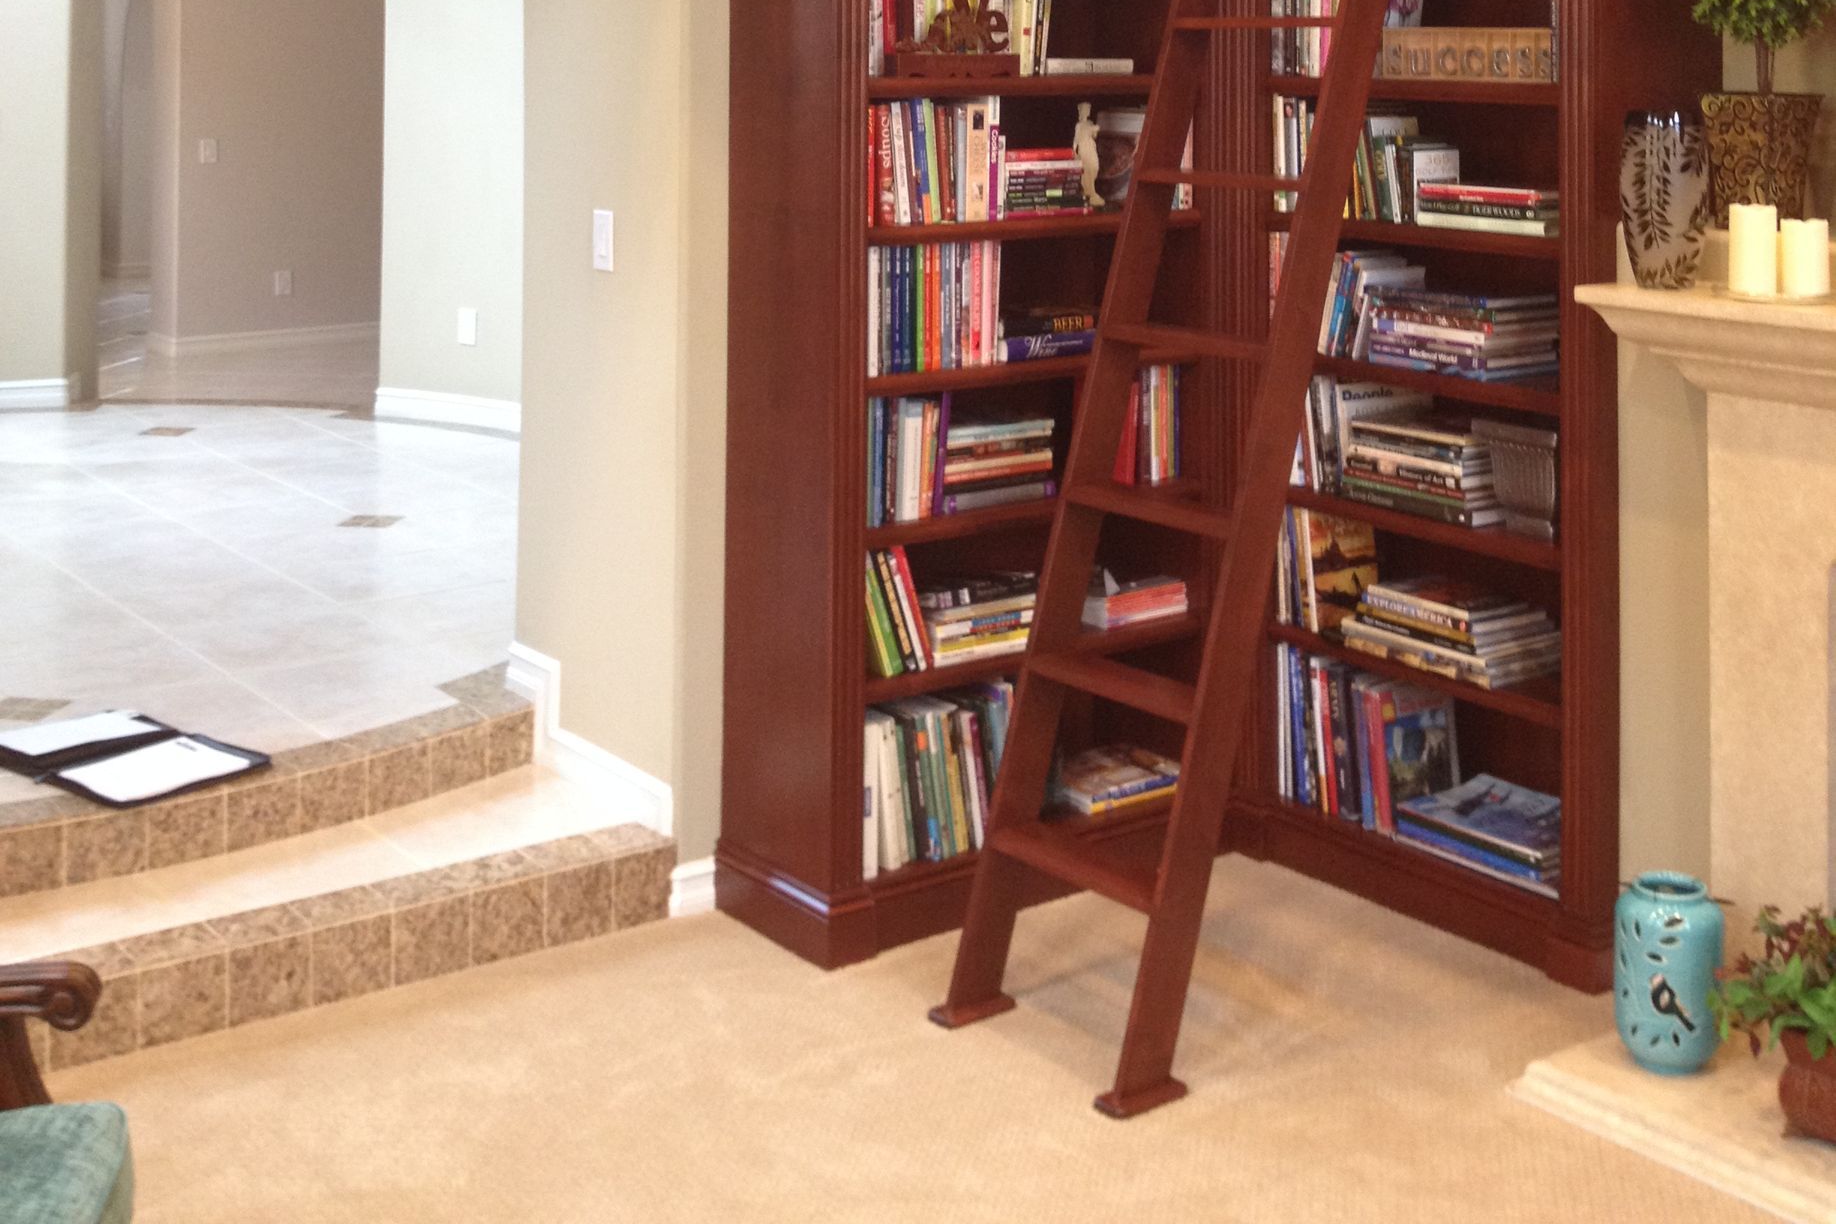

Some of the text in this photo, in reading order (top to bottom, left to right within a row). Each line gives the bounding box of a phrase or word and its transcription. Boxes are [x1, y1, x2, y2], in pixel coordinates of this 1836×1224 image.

[879, 116, 892, 168] Soups
[990, 129, 999, 164] Cookies
[1053, 316, 1083, 331] BEER
[1408, 347, 1438, 362] Medieval
[1438, 352, 1458, 364] World
[1366, 592, 1408, 612] EXPLORE
[1408, 604, 1453, 627] AMERICA
